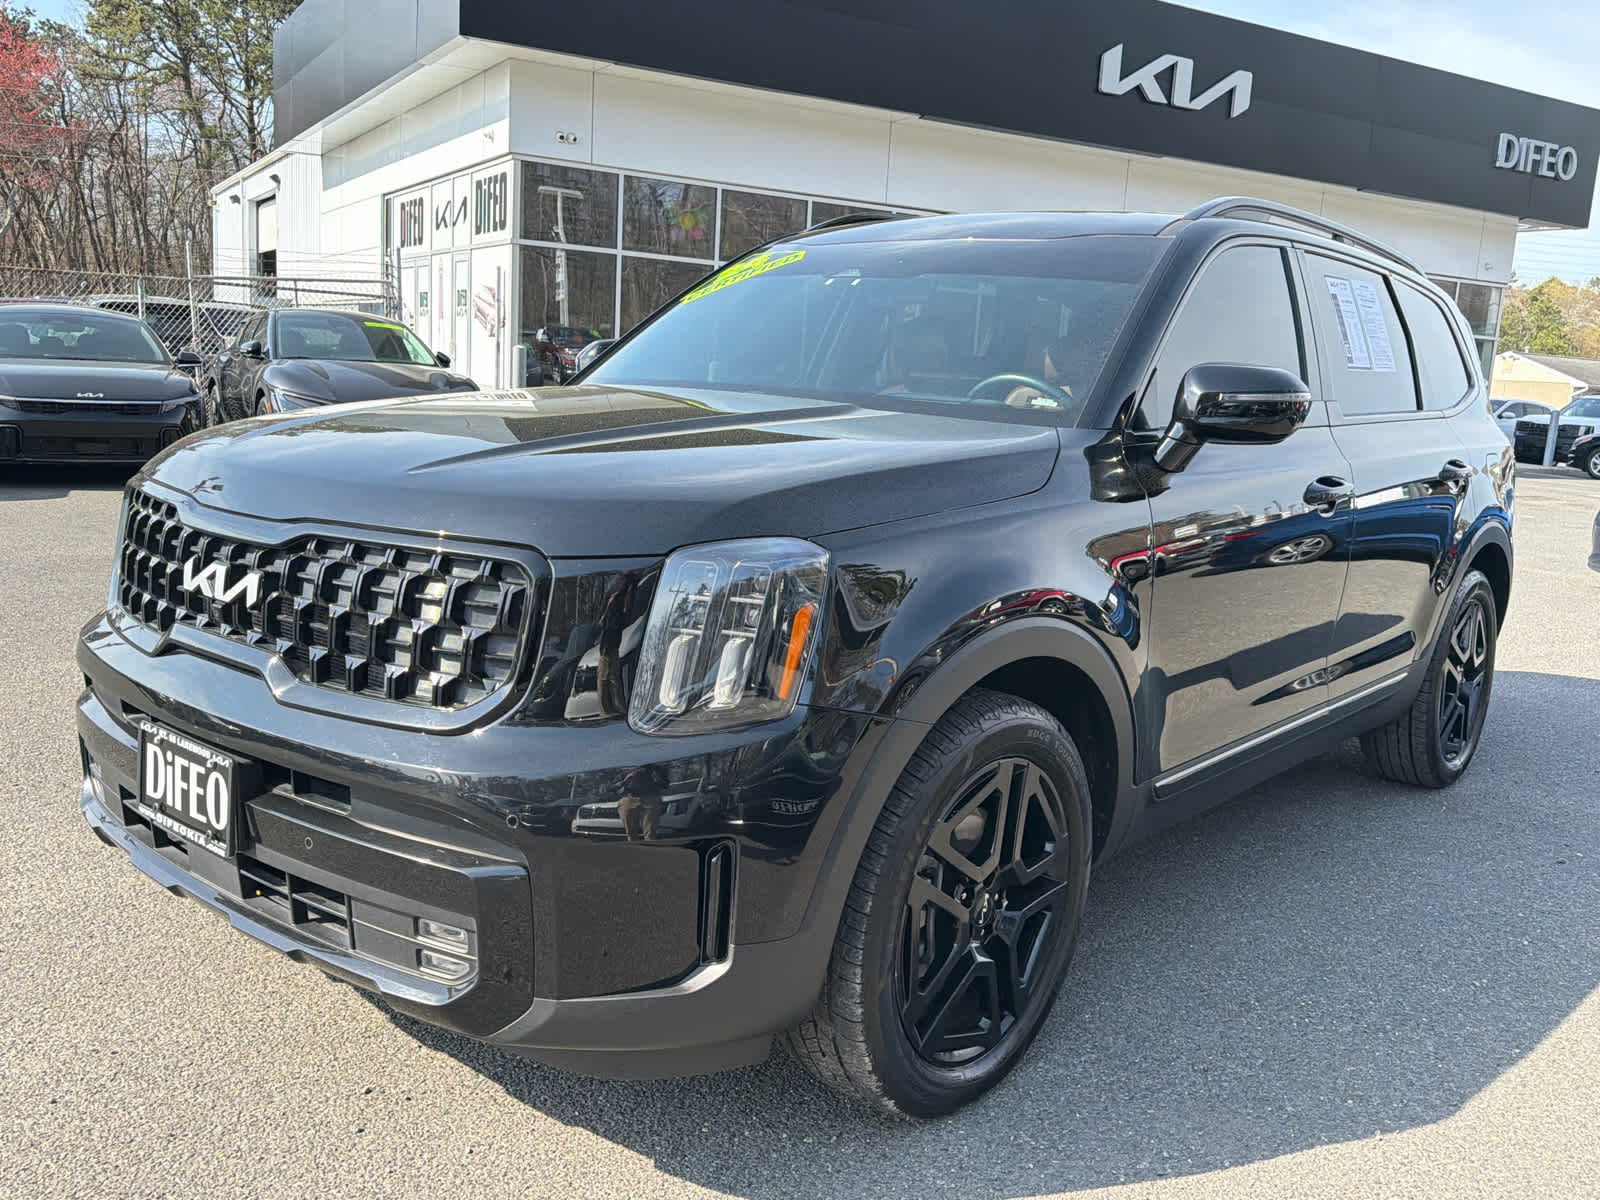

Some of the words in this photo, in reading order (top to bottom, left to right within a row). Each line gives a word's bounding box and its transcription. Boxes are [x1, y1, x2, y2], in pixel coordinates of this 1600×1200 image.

[1098, 43, 1253, 119] KIA
[1496, 132, 1578, 181] DIFEO
[183, 554, 261, 608] KIA
